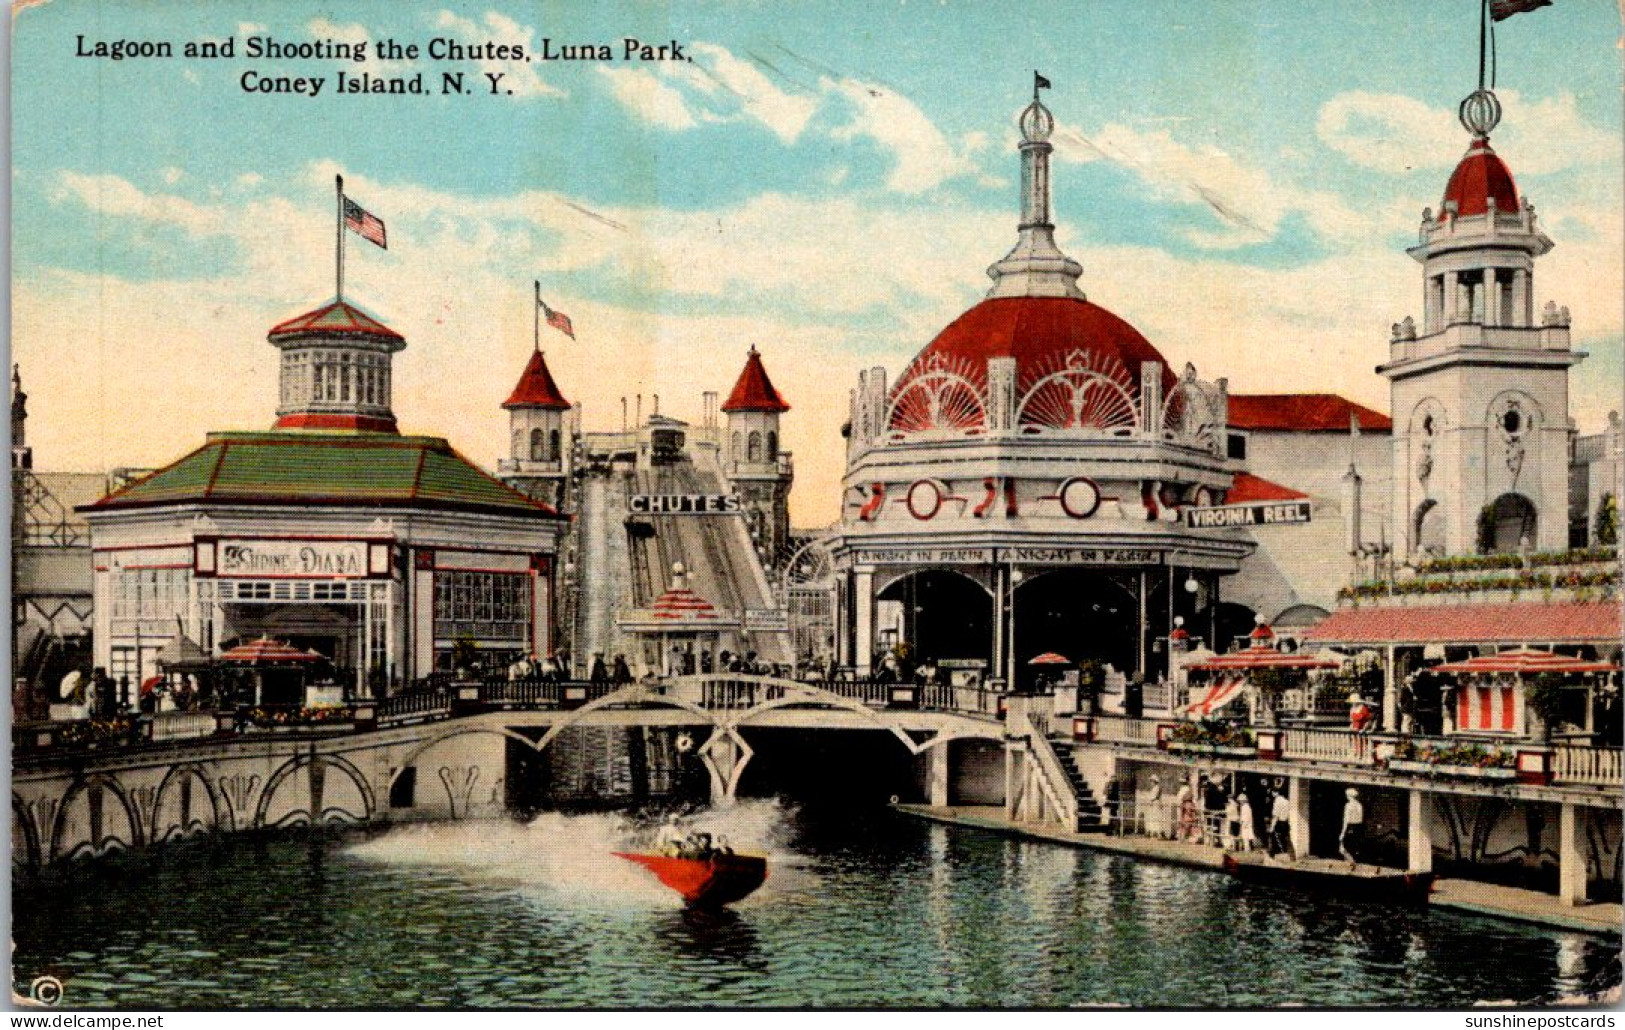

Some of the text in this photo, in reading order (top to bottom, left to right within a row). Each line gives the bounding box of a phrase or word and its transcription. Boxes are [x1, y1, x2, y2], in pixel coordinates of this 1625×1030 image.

[630, 495, 738, 511] CHUTES
[1191, 504, 1307, 527] VIRGINIA REEL
